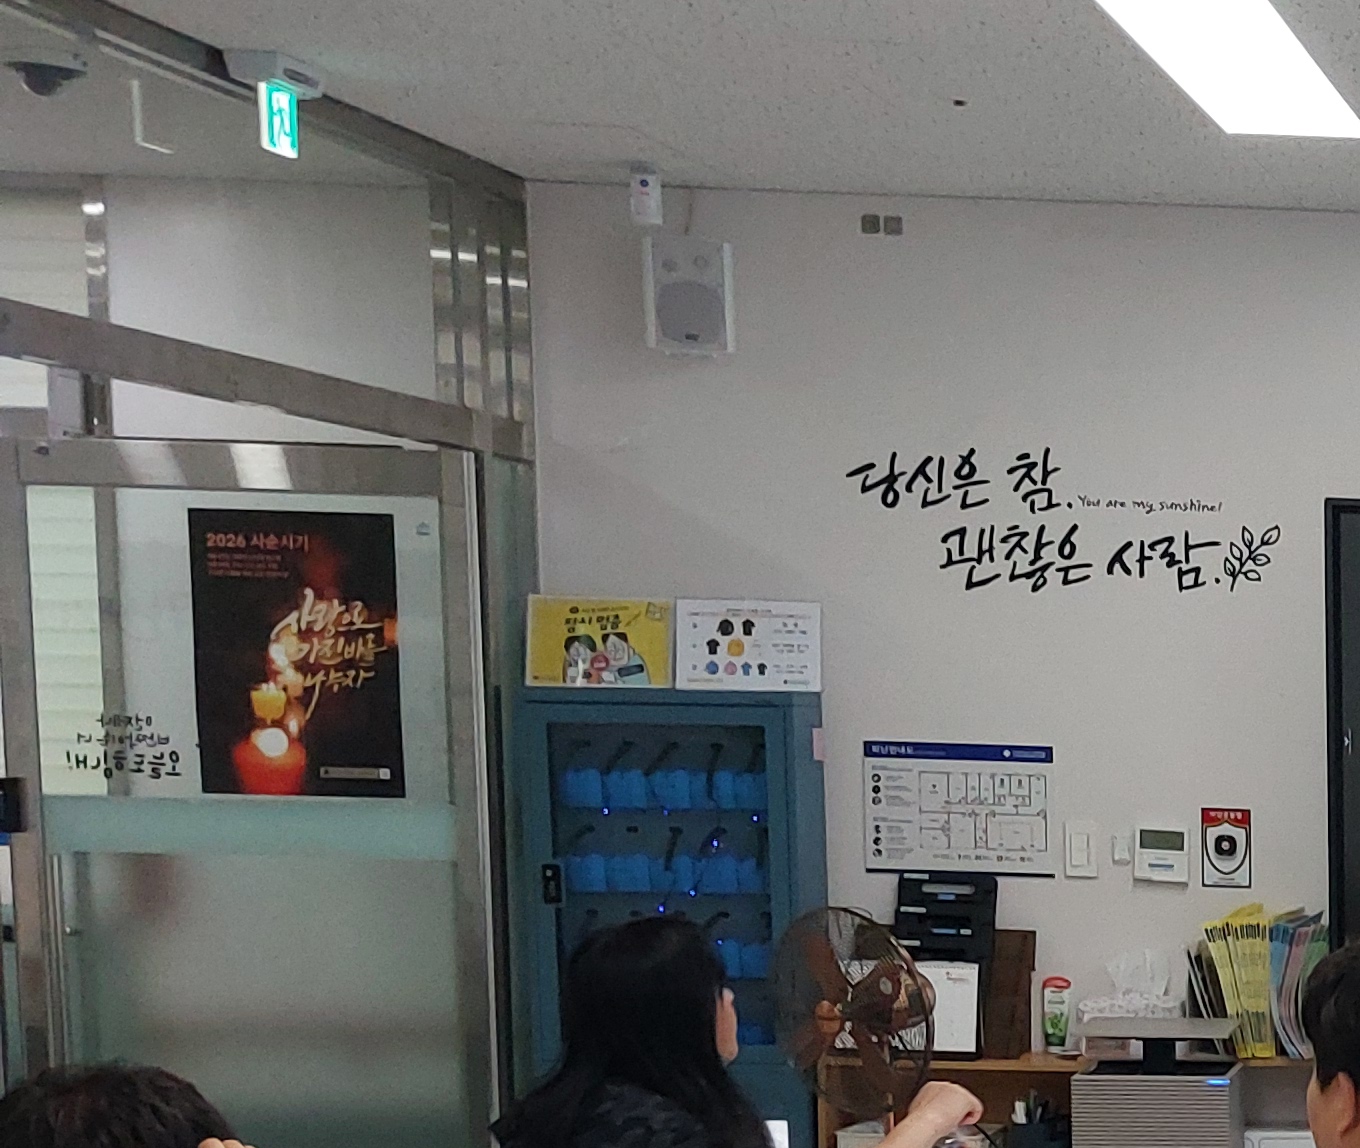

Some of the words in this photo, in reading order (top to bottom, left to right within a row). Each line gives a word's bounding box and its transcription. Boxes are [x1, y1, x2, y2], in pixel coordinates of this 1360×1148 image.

[845, 447, 991, 510] 당신은
[1076, 494, 1101, 508] You
[1105, 499, 1127, 509] are
[1132, 499, 1156, 514] my
[206, 532, 247, 548] 2026
[250, 532, 309, 553] 사순시기
[939, 522, 1094, 593] 괜찮은
